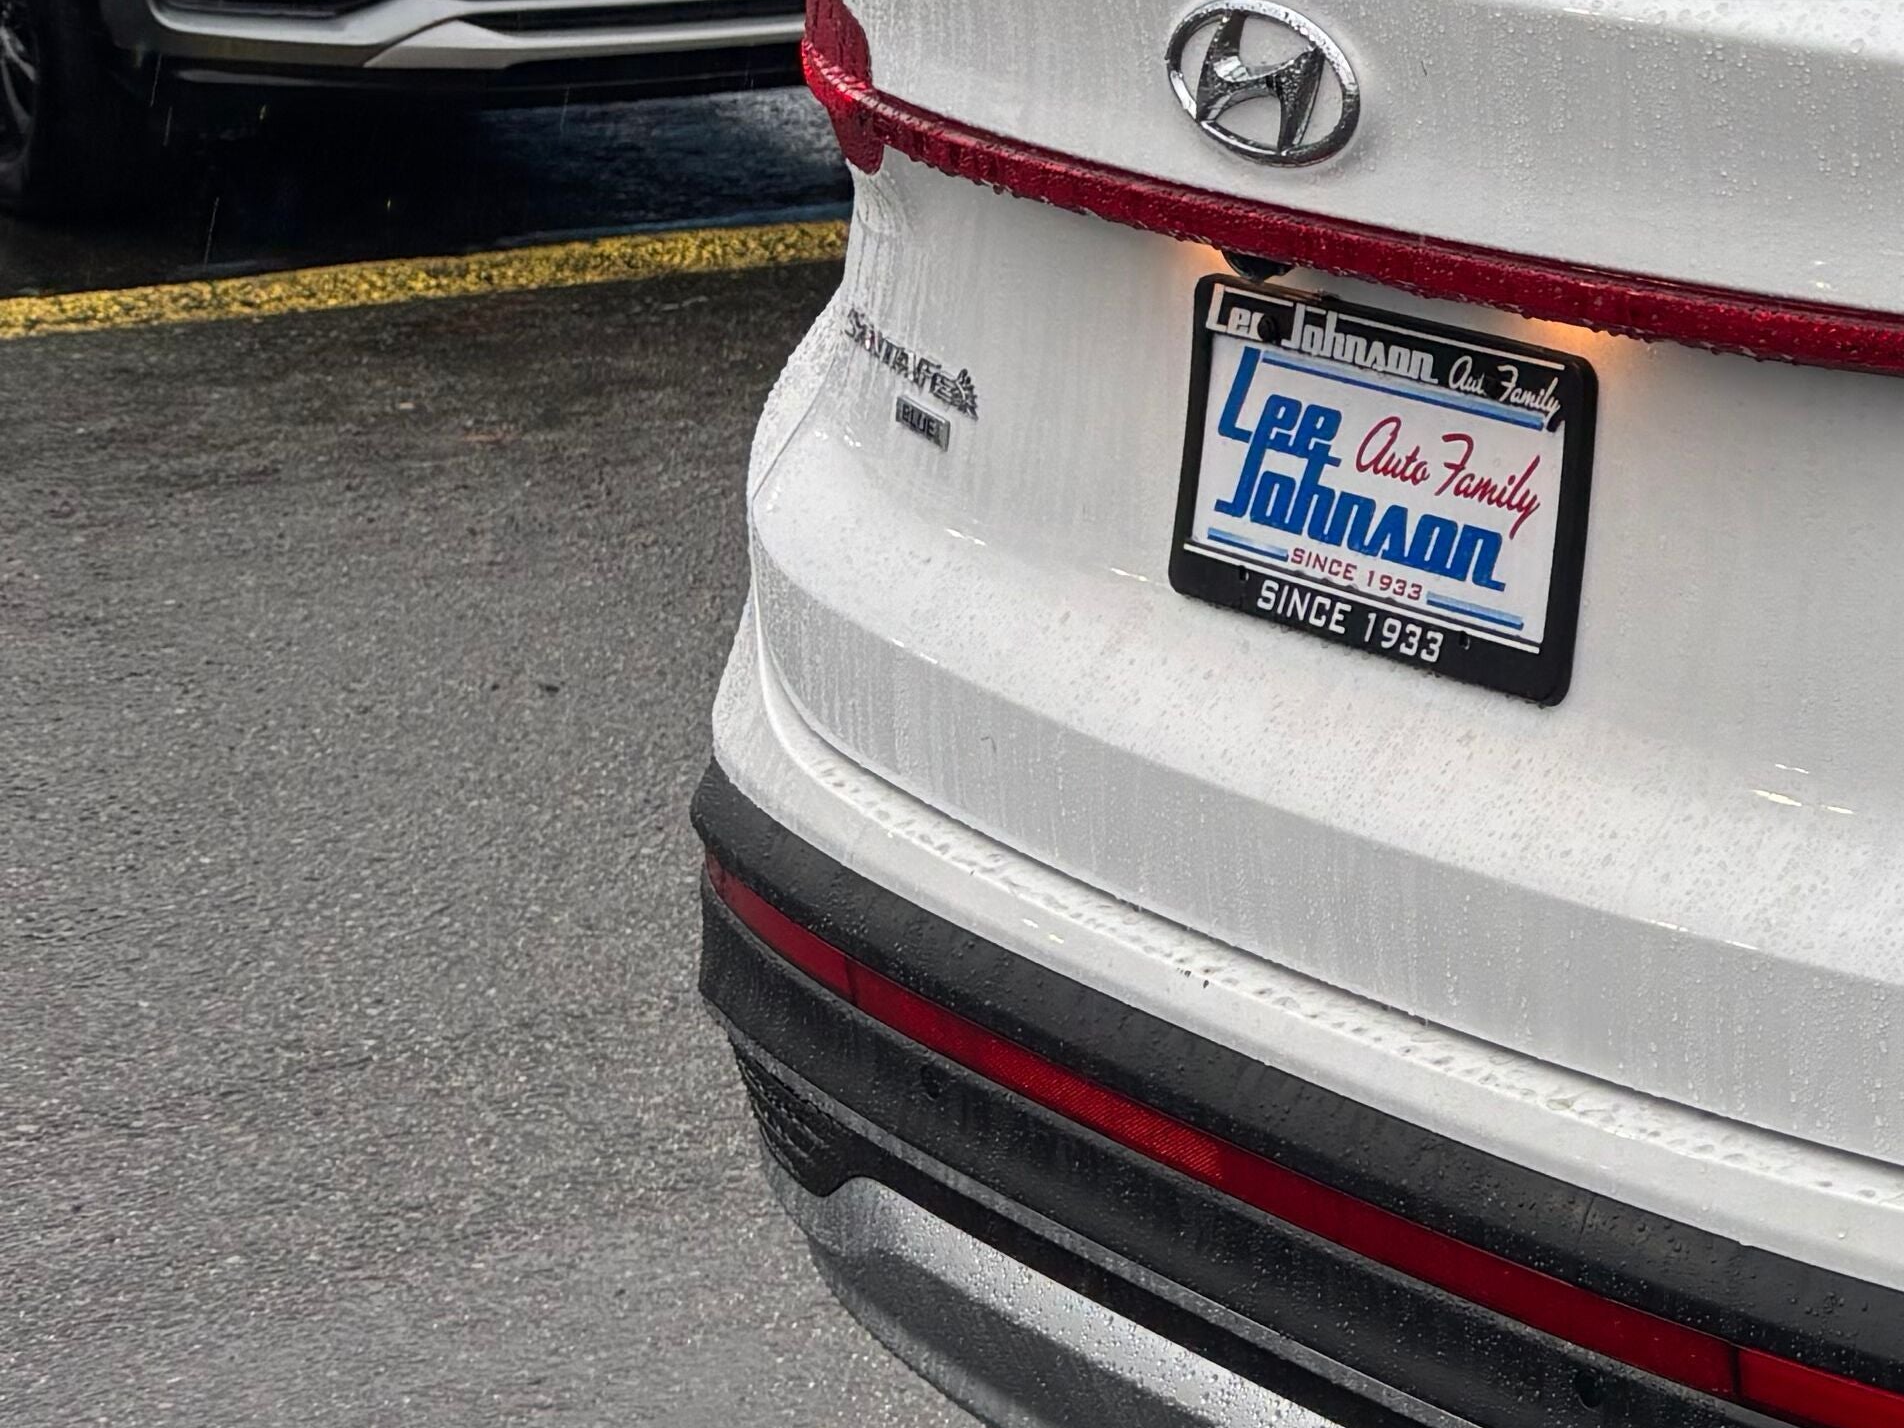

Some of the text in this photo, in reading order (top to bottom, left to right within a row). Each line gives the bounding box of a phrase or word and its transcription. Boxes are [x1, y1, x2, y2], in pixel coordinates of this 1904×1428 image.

[1218, 347, 1343, 459] Lee
[1281, 302, 1439, 385] Johnson
[1448, 355, 1488, 396] Aut
[1496, 364, 1562, 429] Family
[1214, 438, 1506, 592] Johnson
[1355, 416, 1541, 540] Auto Family
[1256, 579, 1444, 664] SINCE 1933
[1290, 547, 1423, 602] SINCE 1933
